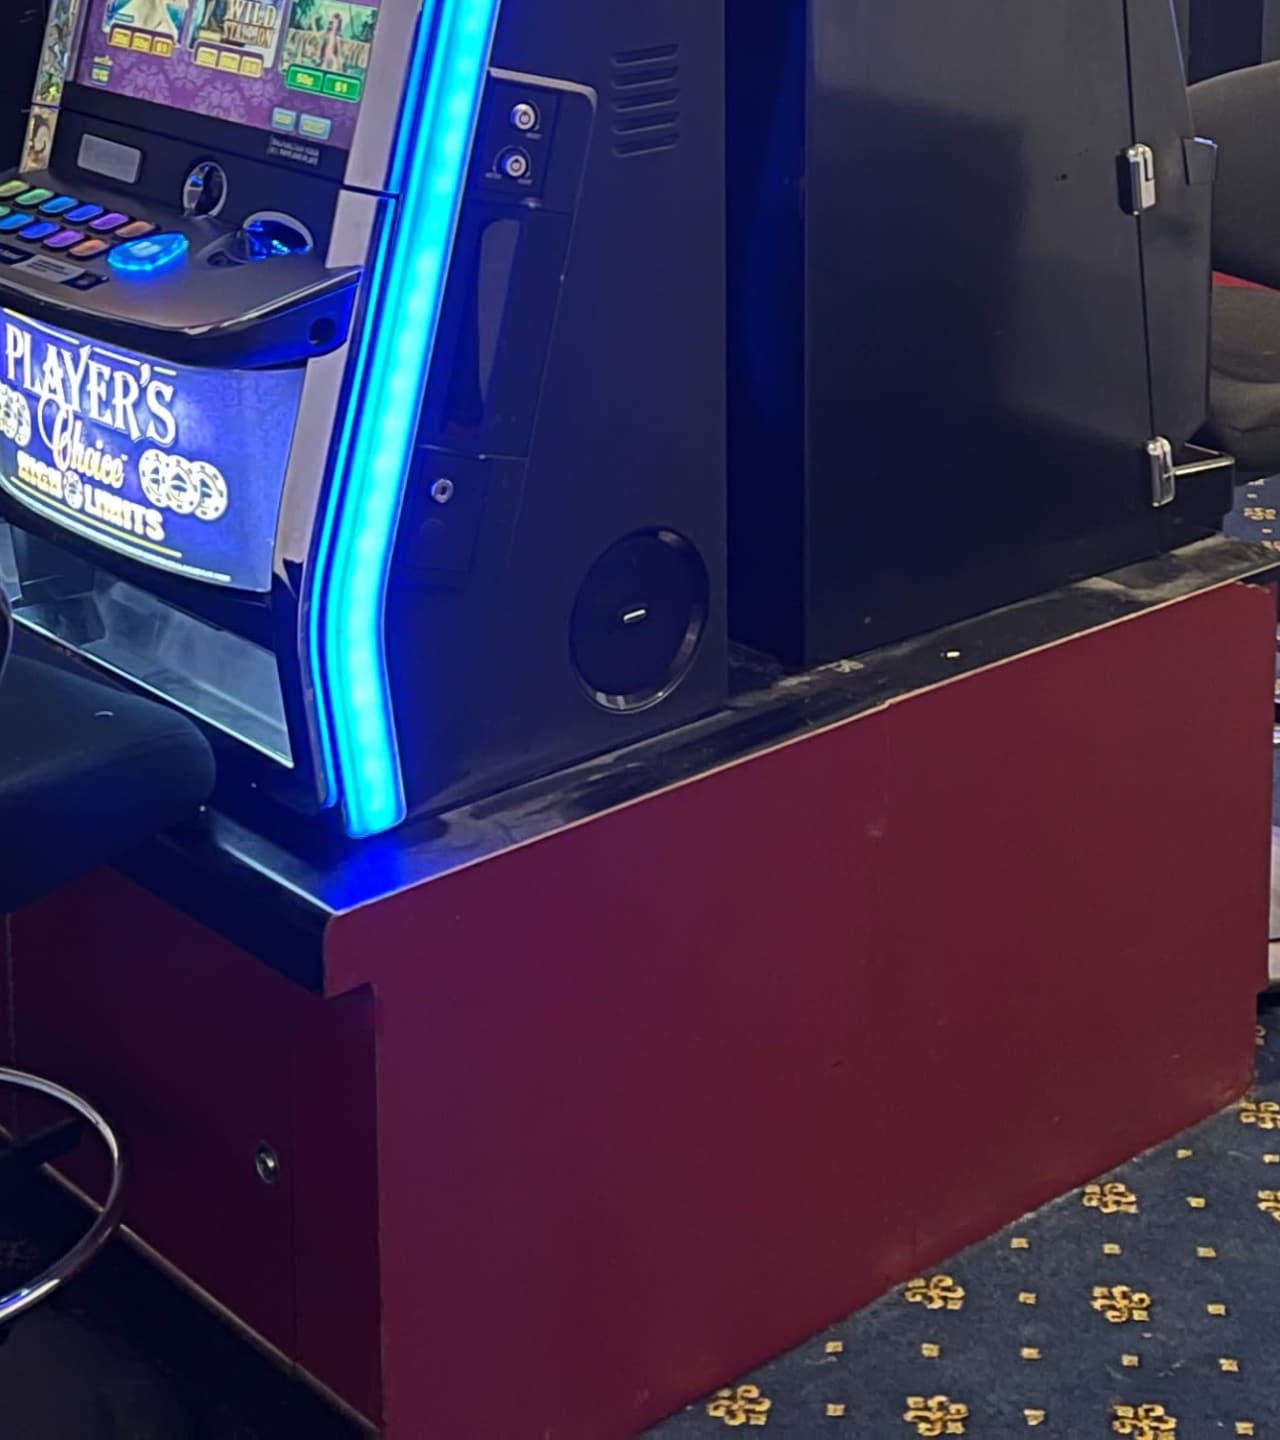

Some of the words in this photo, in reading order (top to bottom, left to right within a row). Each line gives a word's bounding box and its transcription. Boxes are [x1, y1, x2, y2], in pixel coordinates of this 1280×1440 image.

[5, 323, 176, 447] PLAYER'S
[38, 396, 127, 490] Choice
[17, 448, 64, 499] HIGH
[83, 482, 166, 541] LIMITS
